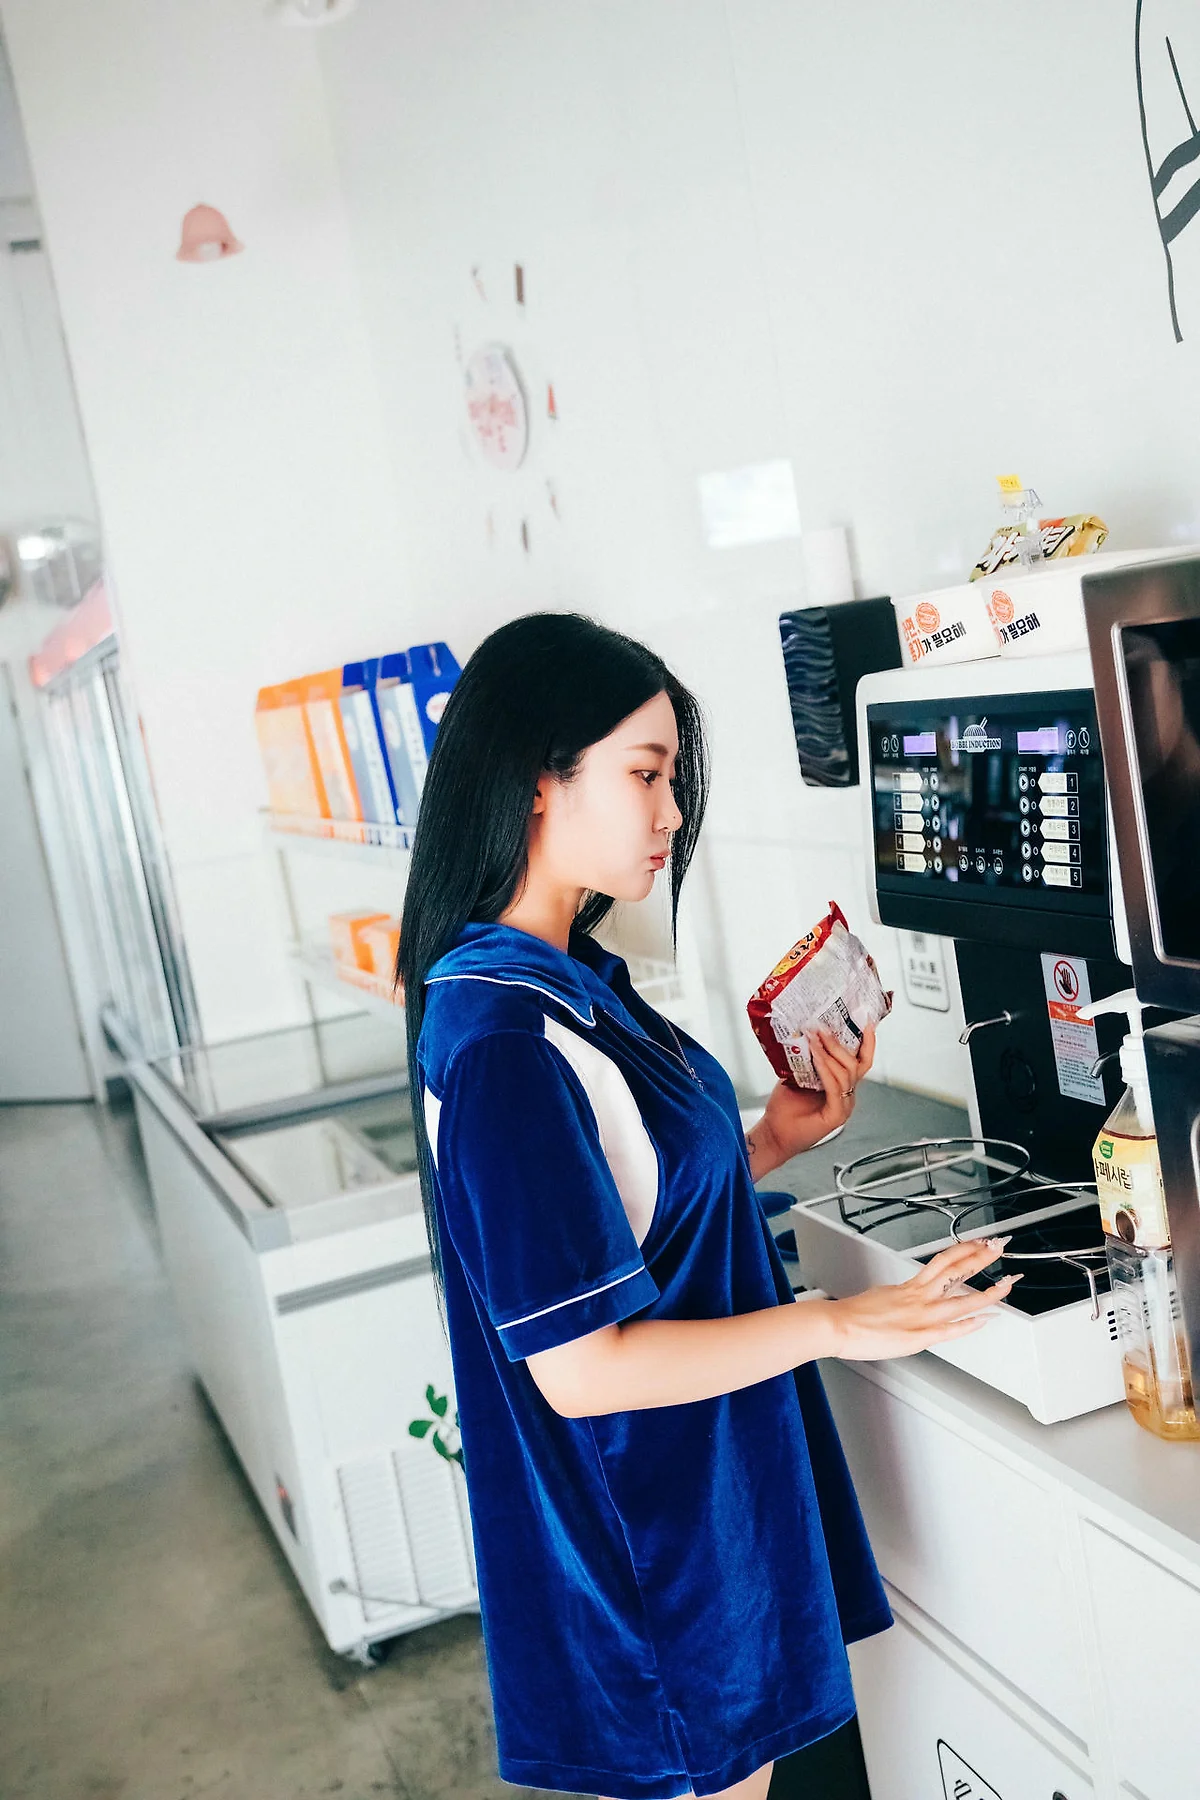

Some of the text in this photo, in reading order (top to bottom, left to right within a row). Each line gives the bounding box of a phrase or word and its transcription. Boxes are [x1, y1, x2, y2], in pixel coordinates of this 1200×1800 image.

[931, 620, 967, 649] 필요해
[1007, 612, 1041, 640] 필요해
[968, 738, 1001, 749] INDUCTION
